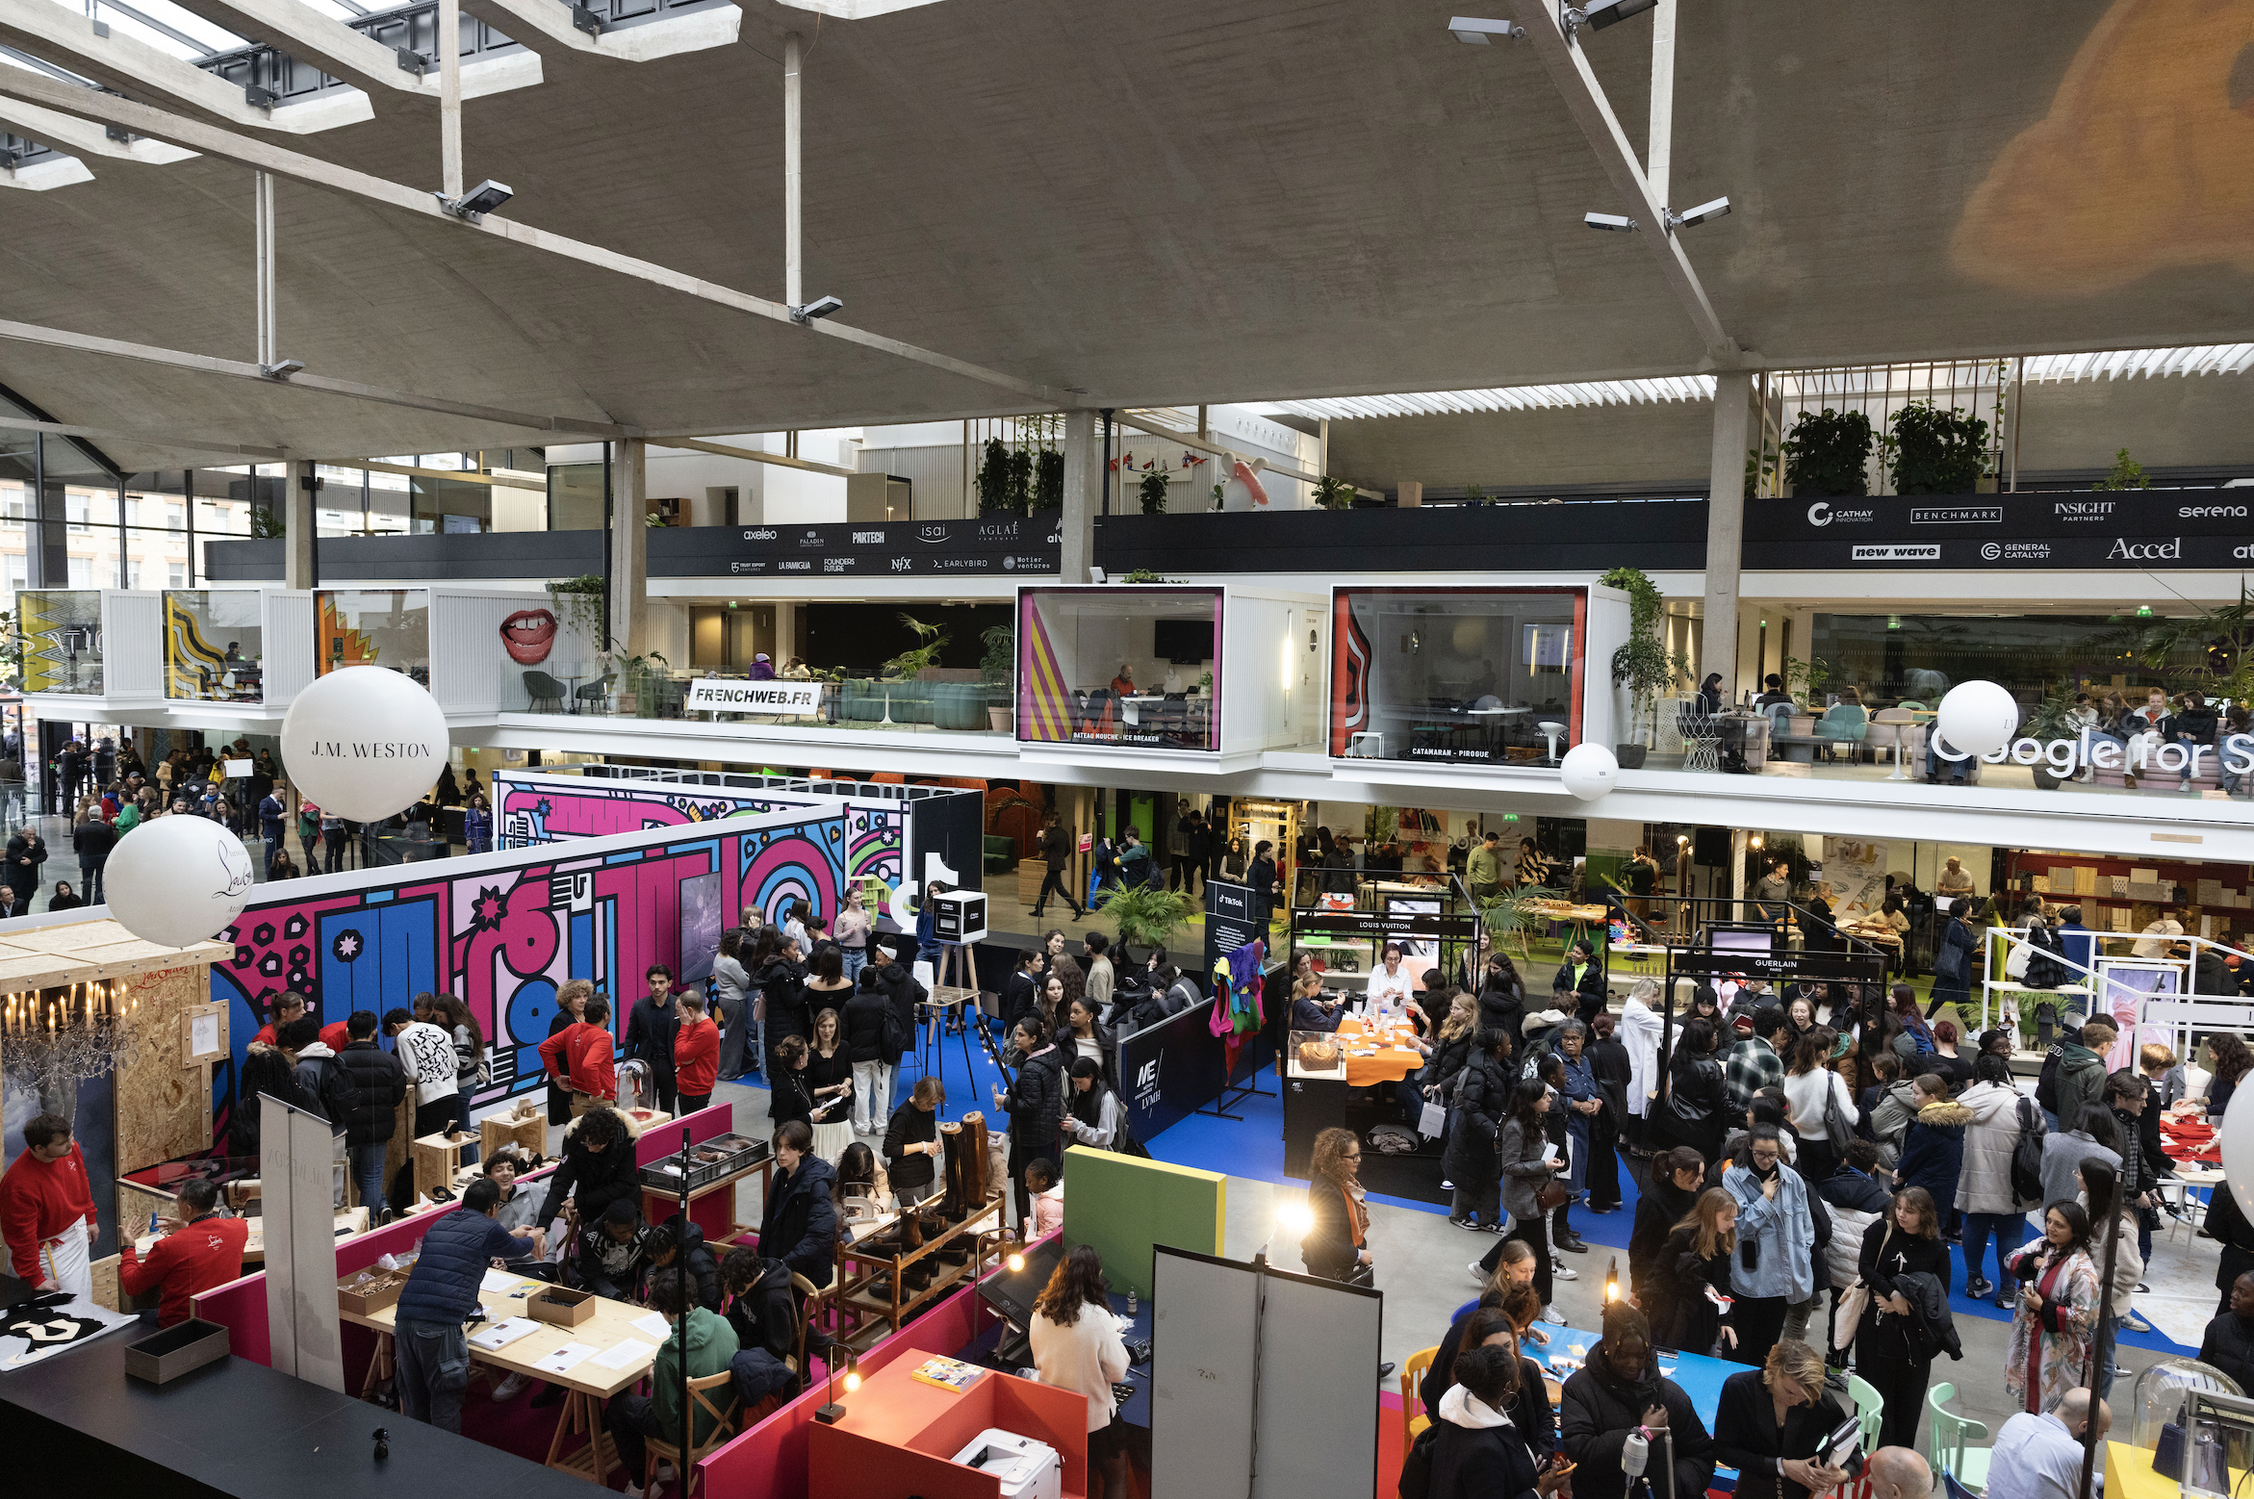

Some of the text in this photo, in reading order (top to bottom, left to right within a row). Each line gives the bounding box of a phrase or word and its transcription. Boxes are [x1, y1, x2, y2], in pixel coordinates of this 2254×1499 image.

[2054, 501, 2116, 515] INSIGHT
[2178, 505, 2249, 519] serena
[1836, 510, 1873, 518] CATHAY
[1915, 511, 1998, 520] BENCHMARK
[921, 523, 946, 537] isai
[978, 521, 1018, 535] AGLAÉ
[743, 527, 778, 541] axeleo
[852, 531, 885, 544] PARTECH
[1855, 545, 1938, 558] new wave
[2004, 543, 2051, 551] GENERAL
[2106, 537, 2181, 560] Accel
[1017, 556, 1042, 564] Motier
[2004, 550, 2051, 559] CATALYST
[778, 561, 785, 570] LA
[823, 557, 855, 566] FOUNDERS
[944, 559, 988, 568] EARLYBIRD
[823, 565, 845, 573] FUTURE
[696, 688, 812, 705] FRENCHWEB.FR
[1073, 731, 1094, 739] BATEAU
[311, 741, 431, 759] J.M. WESTON
[1412, 747, 1451, 757] CATAMARAN
[1458, 749, 1489, 758] PIROGUE
[2139, 730, 2214, 772] for
[1224, 896, 1243, 907] TikTok
[1359, 921, 1379, 929] LOUIS
[1755, 959, 1797, 968] GUERLAIN
[1136, 1059, 1157, 1088] ME
[1141, 1089, 1162, 1110] LVMH
